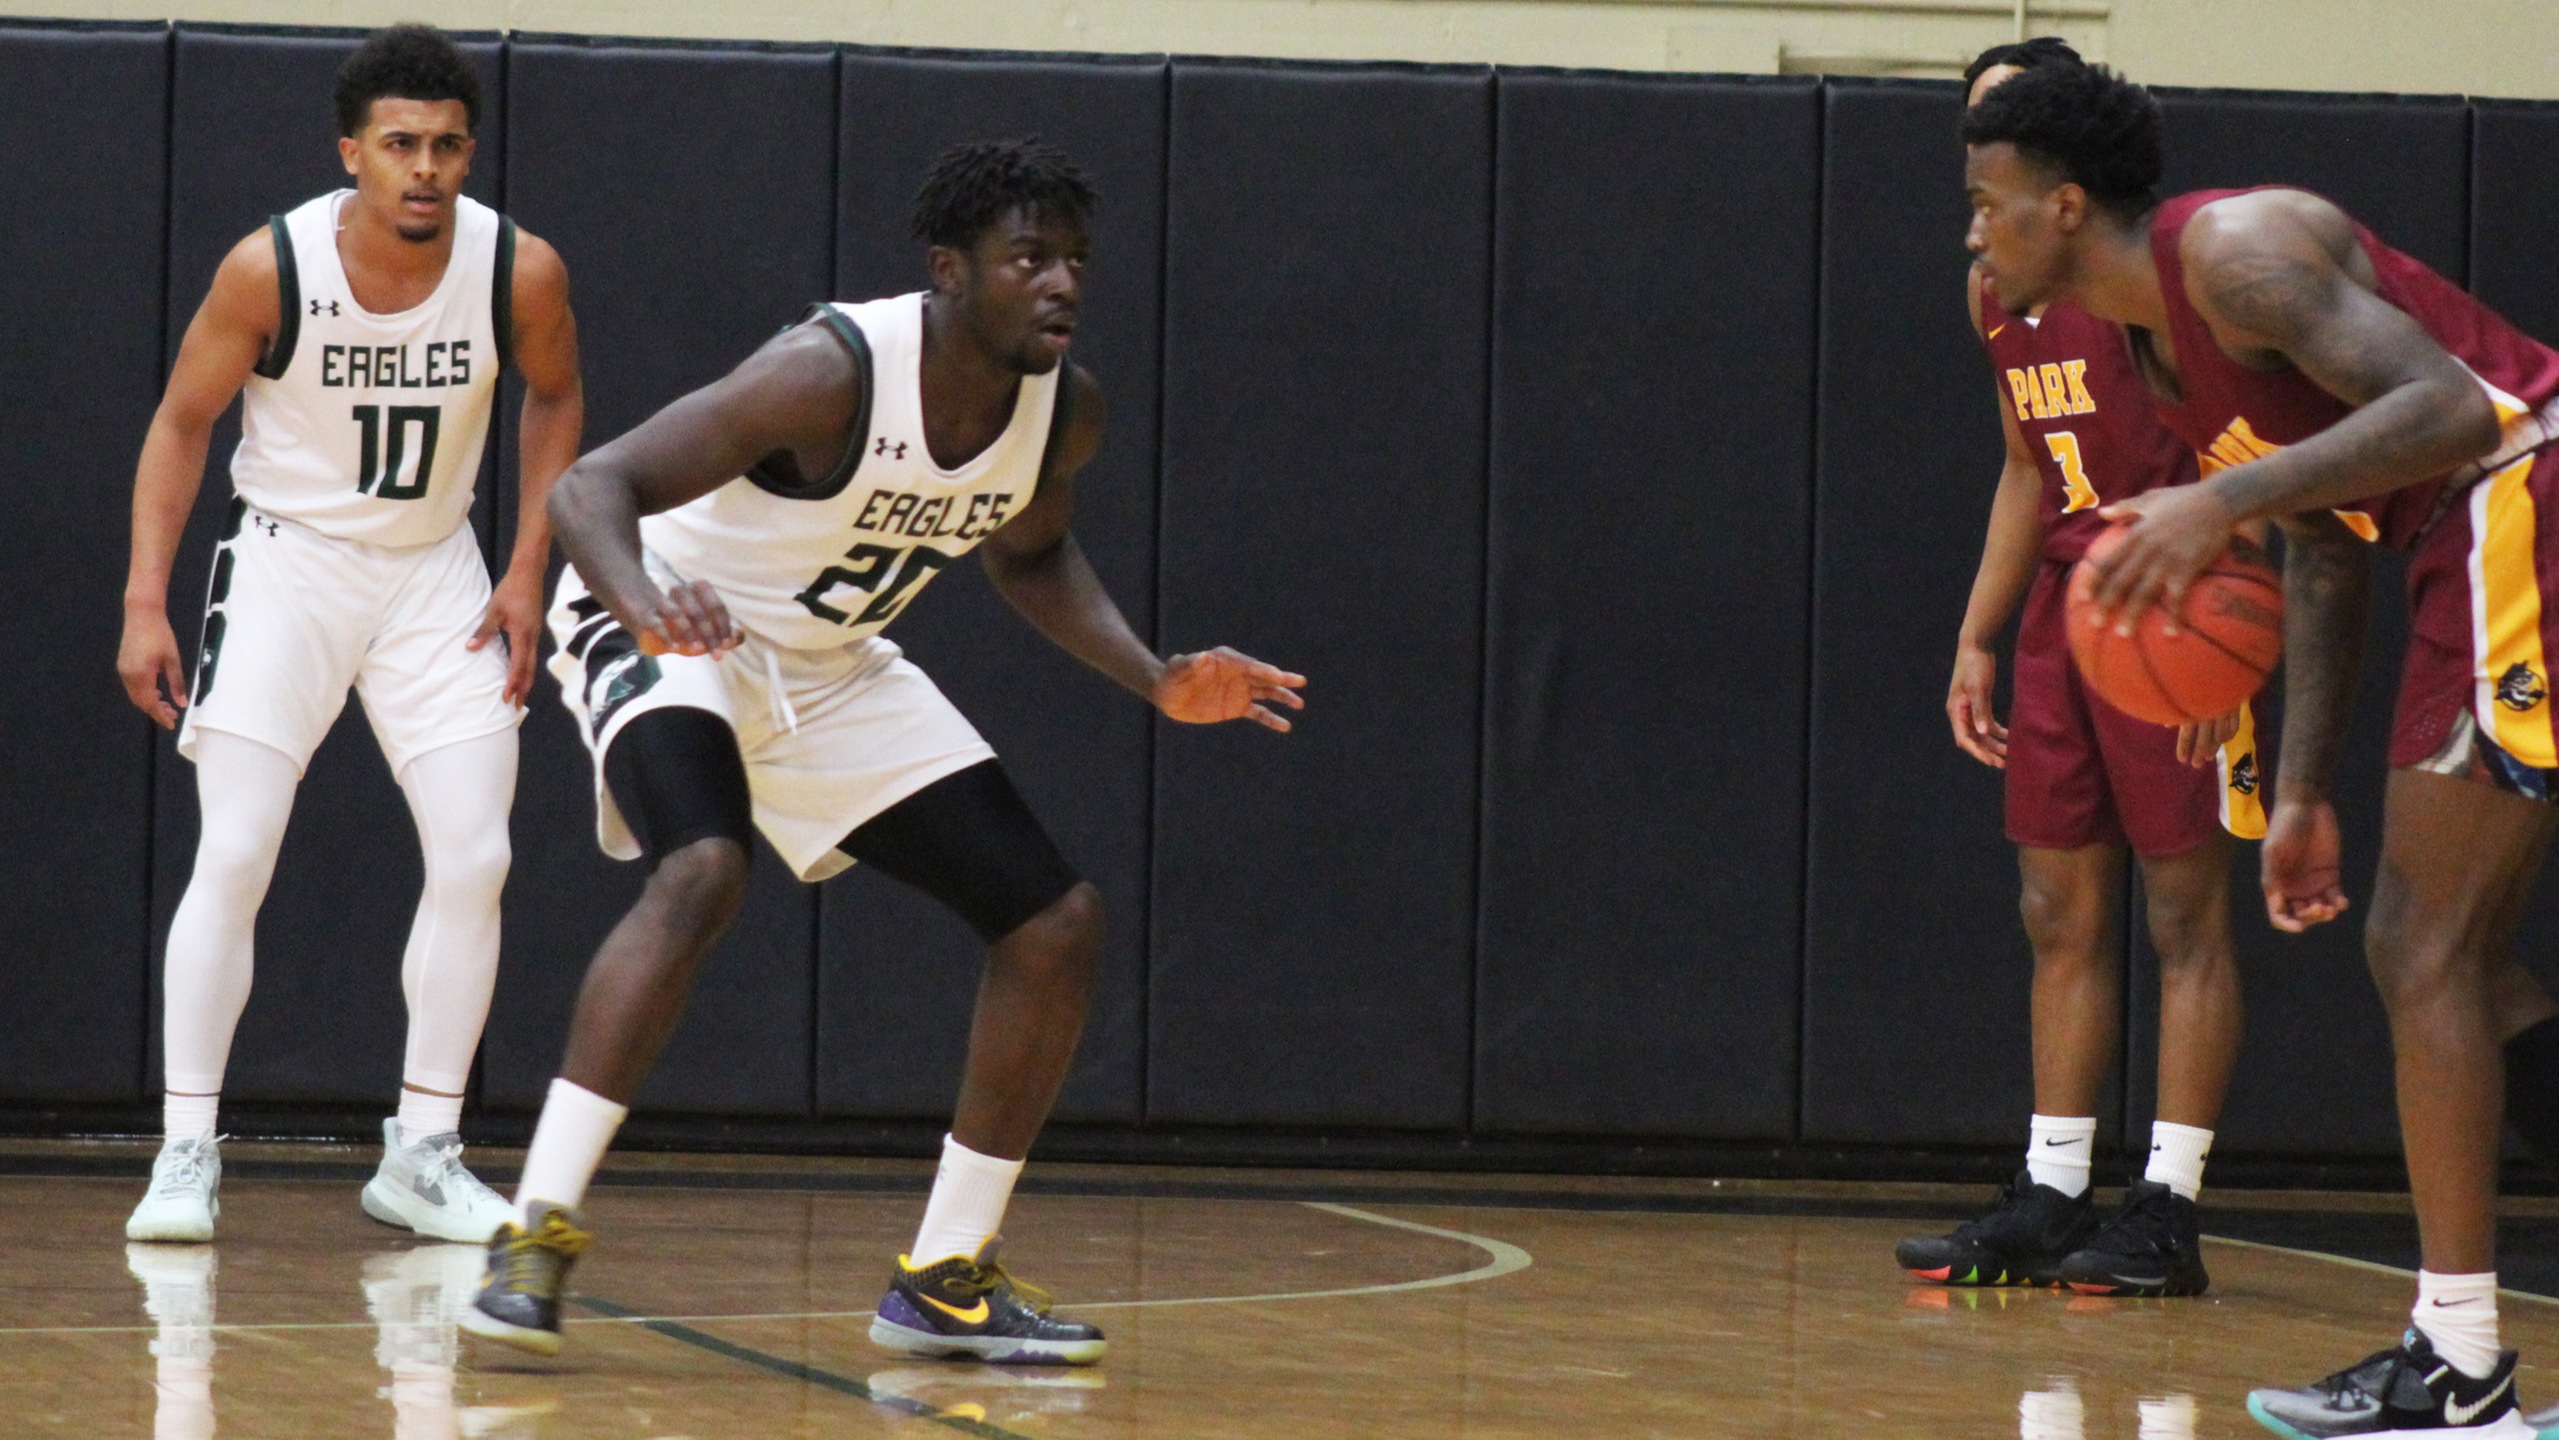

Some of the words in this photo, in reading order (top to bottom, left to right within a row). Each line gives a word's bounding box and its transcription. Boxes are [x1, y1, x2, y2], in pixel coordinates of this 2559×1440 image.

[322, 340, 470, 388] EAGLES
[2006, 358, 2096, 420] PARK
[352, 405, 441, 500] 10
[2044, 431, 2100, 514] 3
[853, 489, 1014, 540] EAGLES
